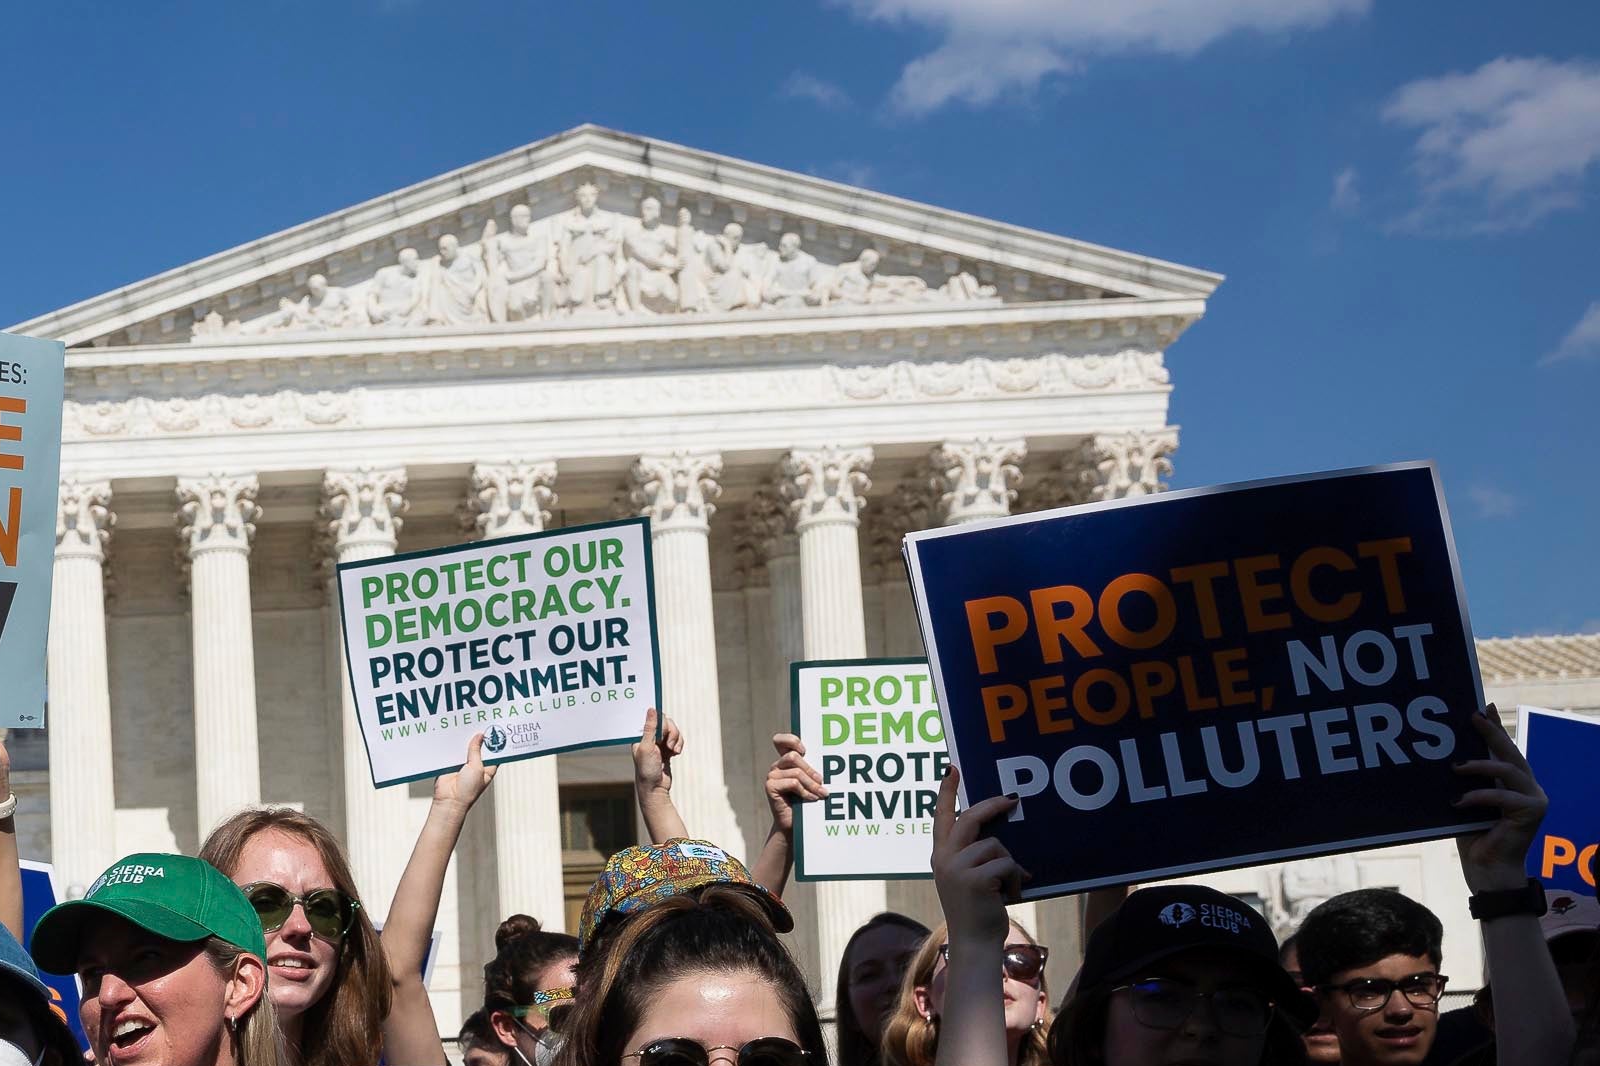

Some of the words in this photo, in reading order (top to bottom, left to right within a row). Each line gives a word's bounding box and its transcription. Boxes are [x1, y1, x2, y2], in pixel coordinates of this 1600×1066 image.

[361, 551, 532, 608] PROTECT
[543, 538, 624, 578] OUR
[365, 574, 631, 649] DEMOCRACY.
[963, 536, 1413, 675] PROTECT
[369, 629, 536, 689] PROTECT
[548, 617, 631, 656] OUR
[980, 646, 1276, 743] PEOPLE,
[1286, 622, 1435, 697] NOT
[375, 655, 636, 726] ENVIRONMENT.
[381, 687, 636, 741] WWW.SIERRACLUB.ORG
[820, 675, 937, 707] PROT
[511, 732, 539, 744] CLUB
[995, 694, 1456, 823] POLLUTERS
[106, 874, 144, 886] CLUB
[112, 865, 164, 877] SIERRA
[1200, 903, 1251, 928] SIERRA
[1200, 915, 1239, 933] CLUB
